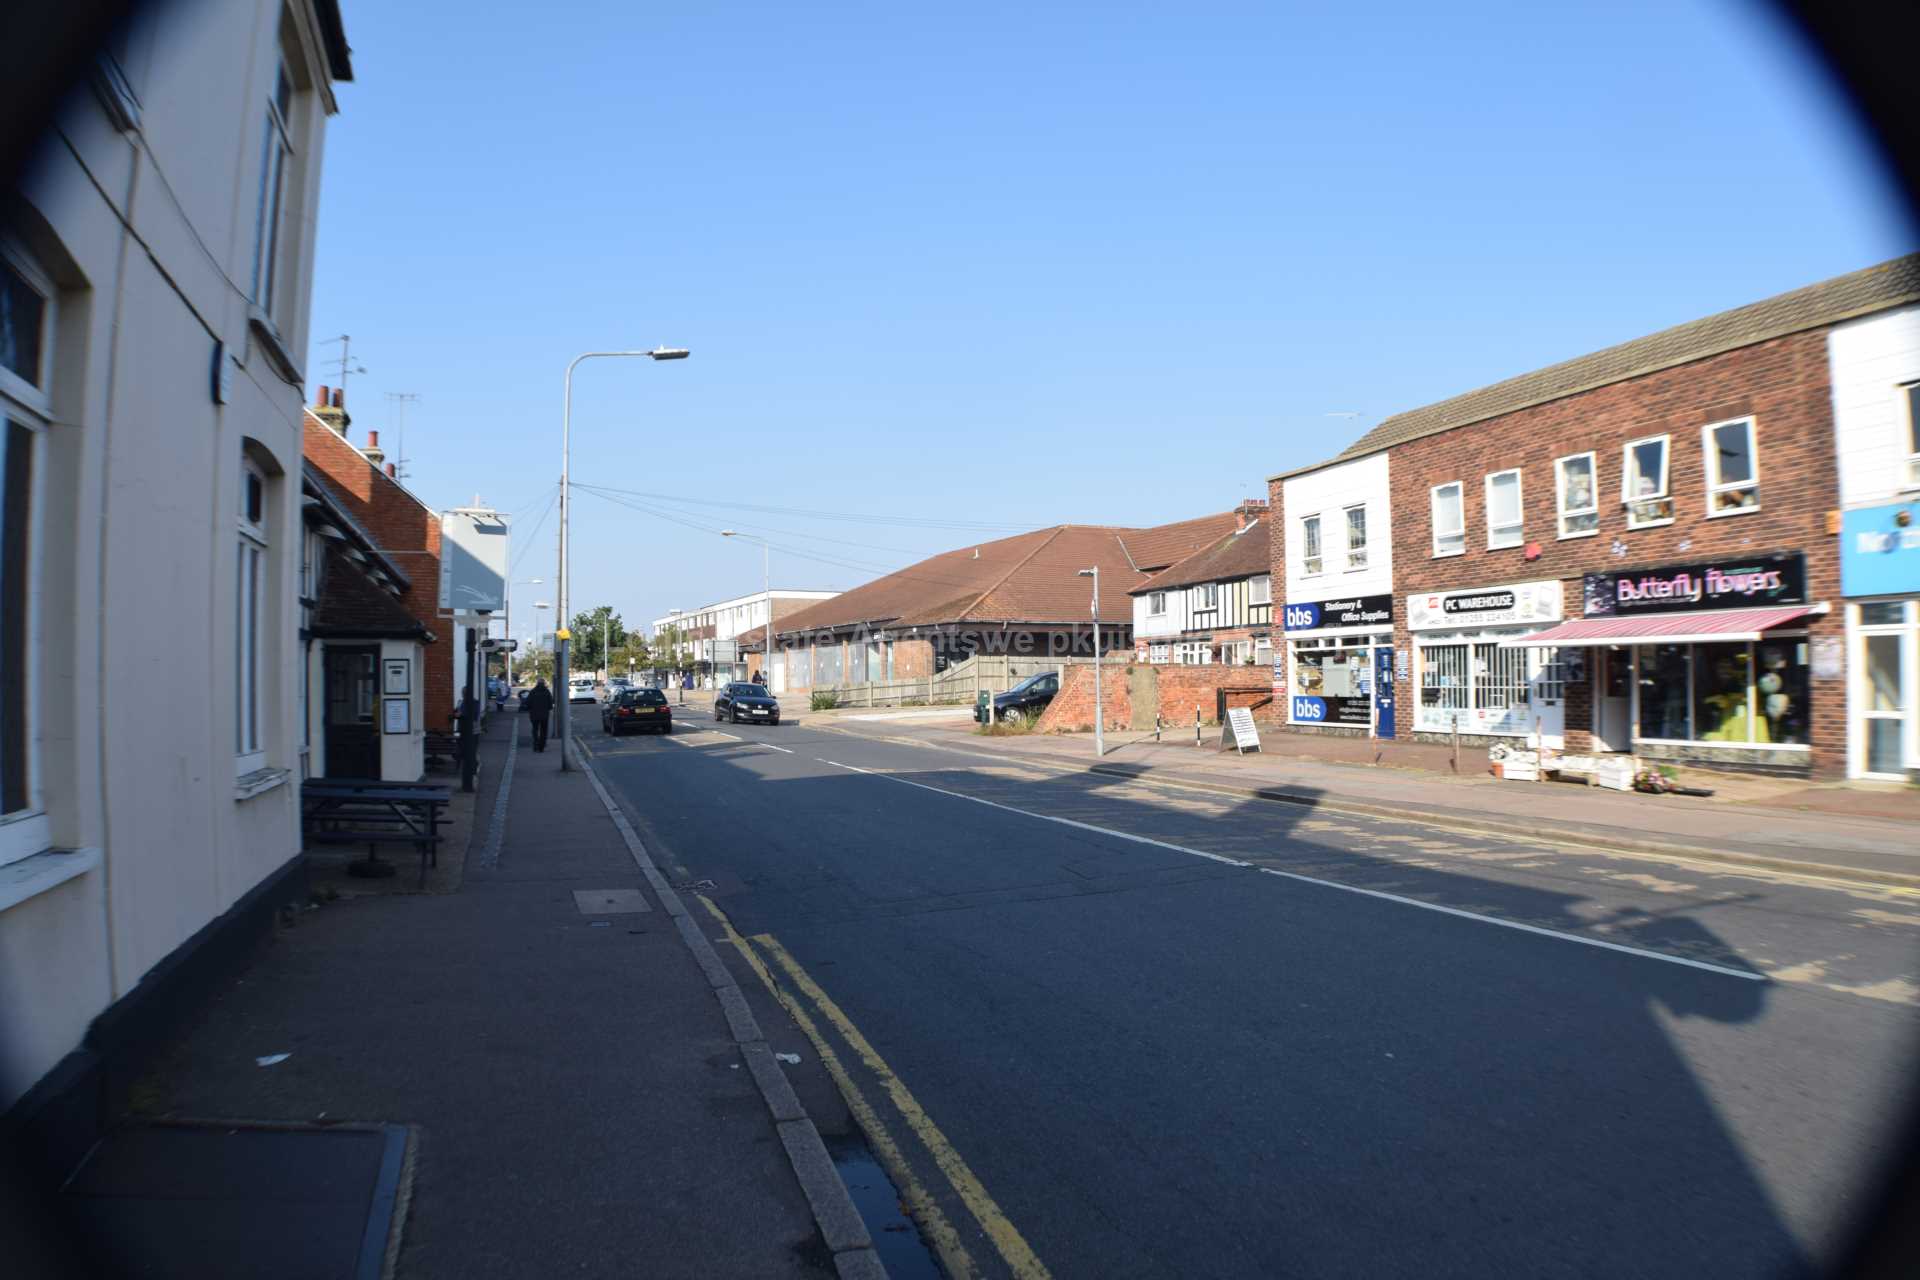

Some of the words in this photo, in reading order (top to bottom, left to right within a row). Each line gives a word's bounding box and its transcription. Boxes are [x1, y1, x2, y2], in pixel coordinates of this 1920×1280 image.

[1617, 573, 1703, 602] Butterfly
[1704, 567, 1783, 597] flowers
[1324, 600, 1356, 612] Stationery
[1356, 599, 1362, 609] &
[1445, 599, 1458, 611] PC
[1458, 594, 1514, 609] WAREHOUSE
[1287, 606, 1313, 627] bbs
[1341, 612, 1360, 622] Office
[1360, 610, 1389, 621] Supplies
[1296, 698, 1321, 718] bbs
